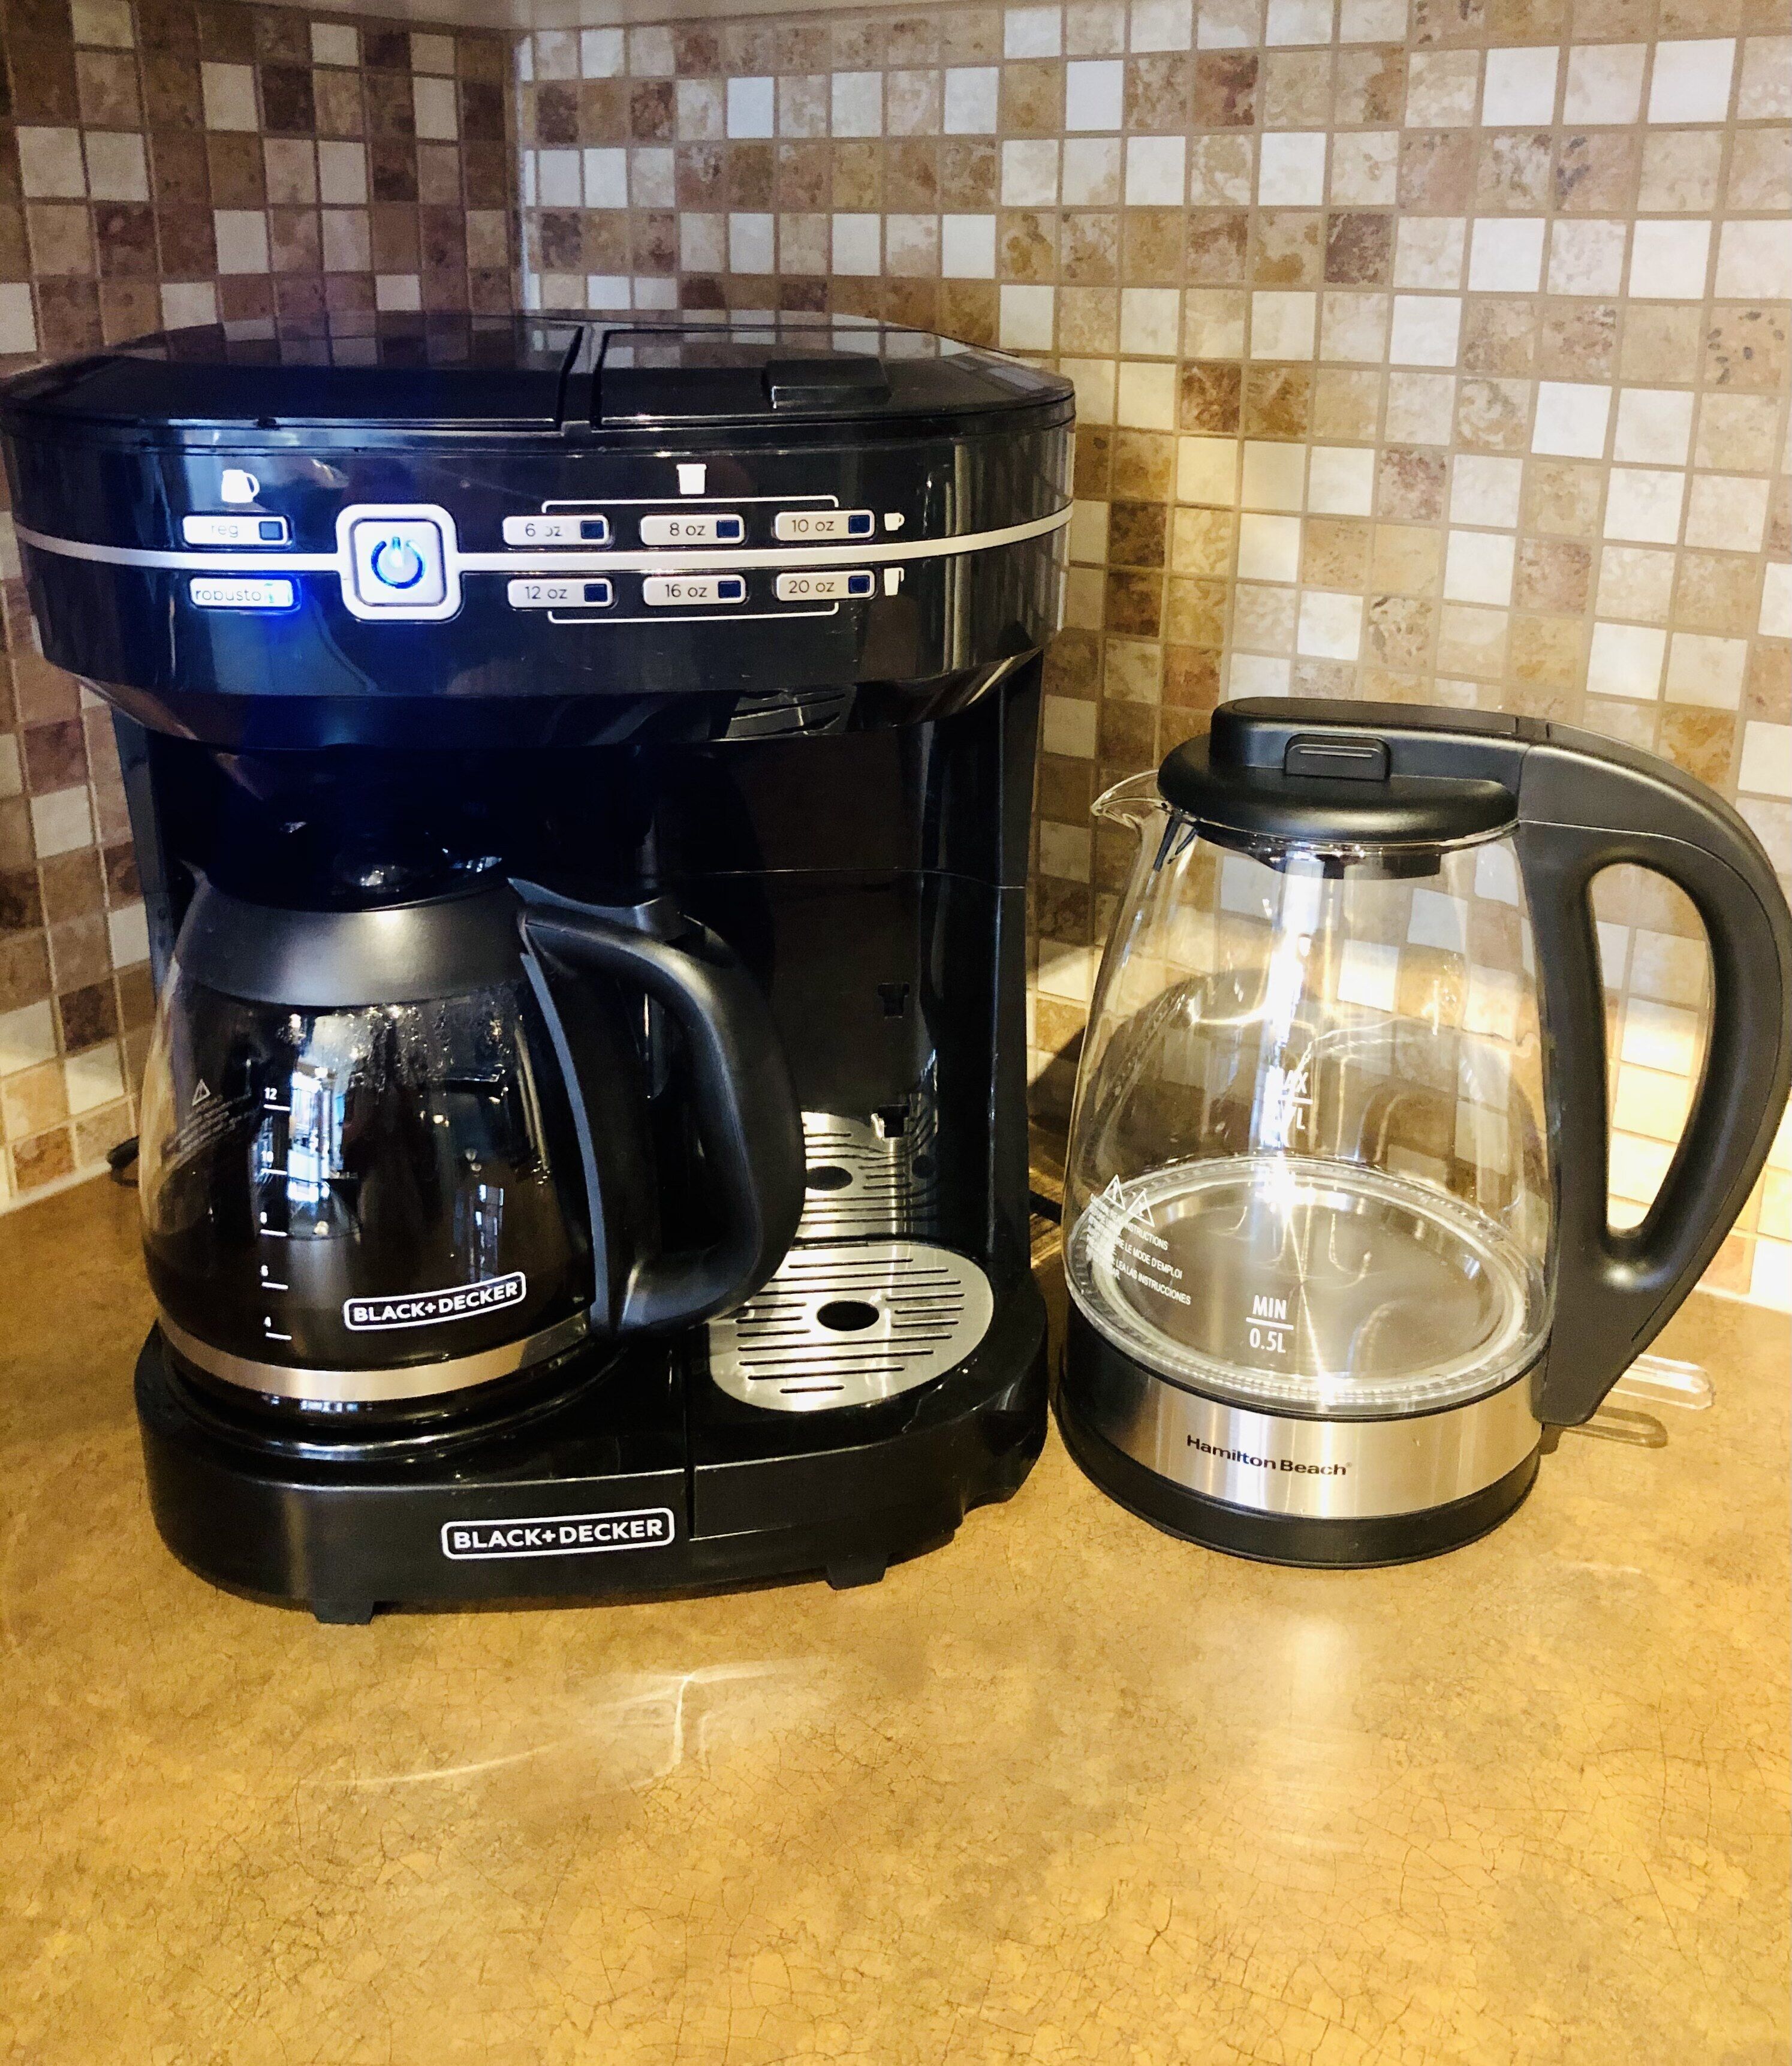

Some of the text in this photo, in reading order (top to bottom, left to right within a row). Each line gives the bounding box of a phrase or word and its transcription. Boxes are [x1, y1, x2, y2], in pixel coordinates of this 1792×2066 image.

[211, 524, 239, 538] reg
[525, 523, 536, 537] 6
[669, 522, 706, 537] 8 oz
[791, 519, 835, 533] 10 oz
[525, 586, 568, 600] 12 oz
[664, 583, 707, 598] 16 oz
[788, 580, 835, 594] 20 oz
[195, 589, 262, 602] robusto
[264, 1086, 278, 1100] 12
[261, 1150, 274, 1163] 10
[1133, 1246, 1155, 1266] MODE
[1151, 1257, 1183, 1280] D'EMPLOI
[1138, 1272, 1192, 1306] INSTRUCCIONES
[353, 1281, 518, 1322] BLACK+DECKER
[1252, 1294, 1287, 1320] MIN
[1249, 1327, 1287, 1353] 0.5L
[1186, 1434, 1347, 1476] Hamilton Beach
[453, 1519, 664, 1550] BLACK+DECKER
